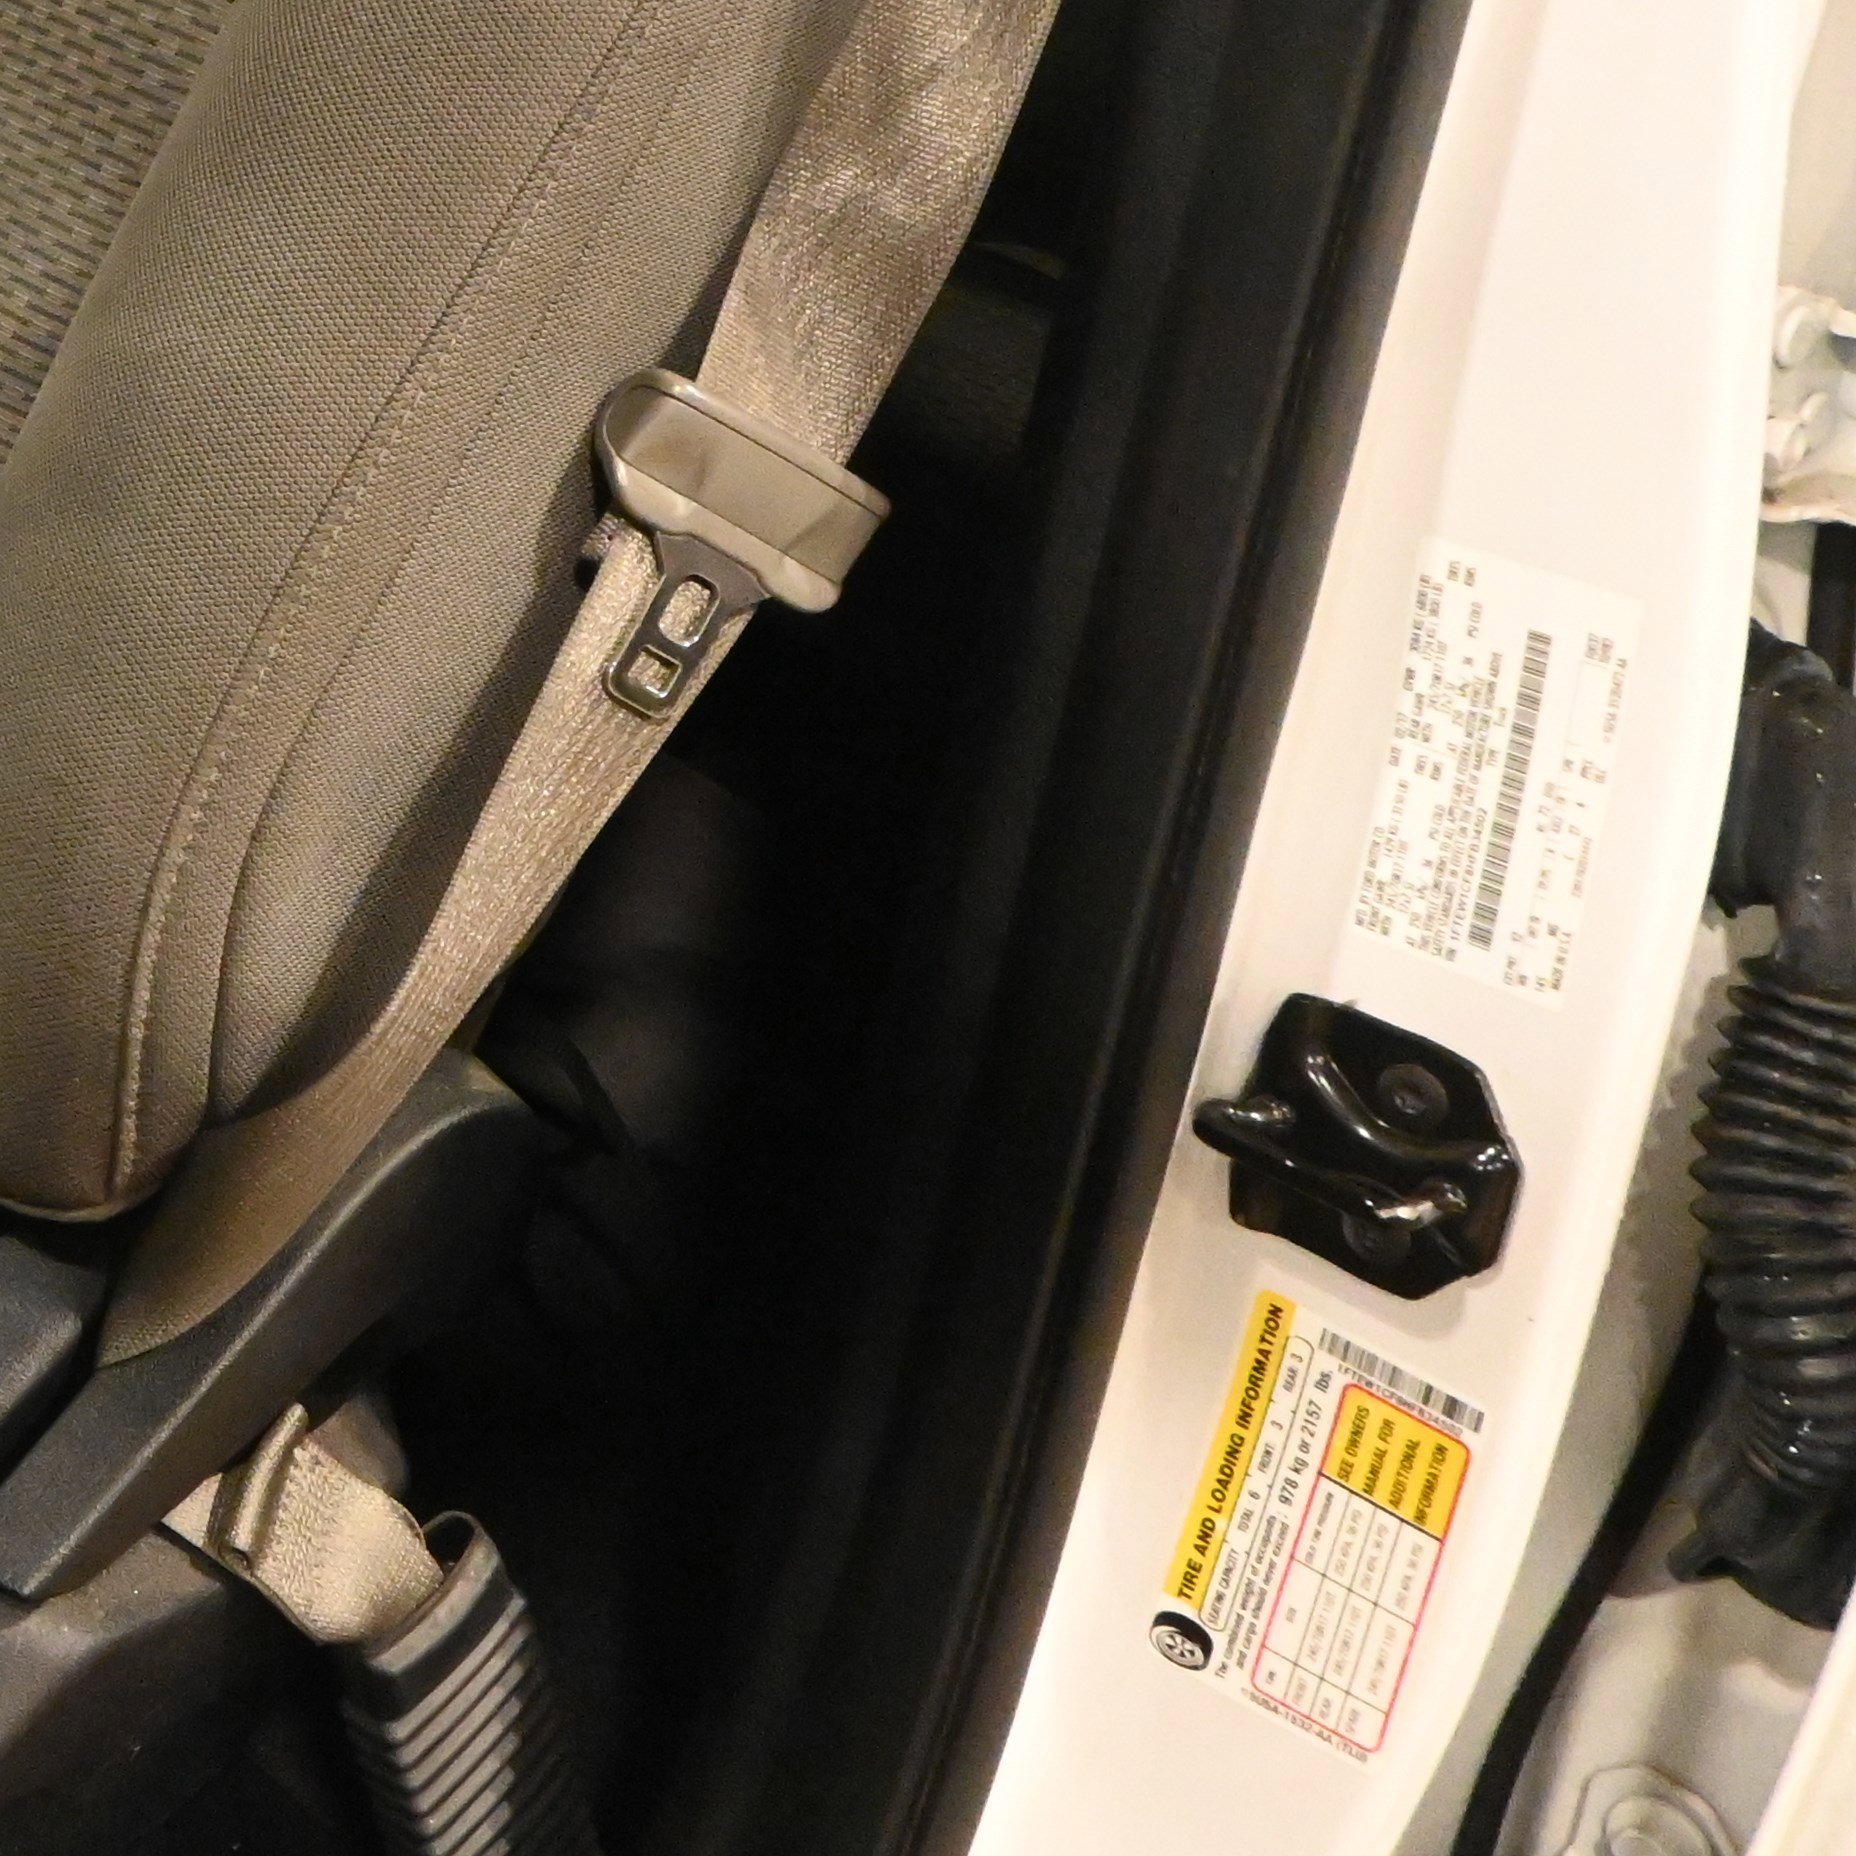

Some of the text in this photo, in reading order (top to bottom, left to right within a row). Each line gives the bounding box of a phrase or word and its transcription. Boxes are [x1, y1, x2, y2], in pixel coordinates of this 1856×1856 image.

[1482, 679, 1497, 710] SHOWN
[1487, 651, 1502, 678] ABOVE
[1462, 709, 1477, 739] MOTOR
[1442, 825, 1454, 840] ALL
[1460, 809, 1471, 823] THE
[1464, 786, 1476, 807] DATE
[1440, 841, 1450, 852] TO
[1431, 928, 1445, 957] SAFETY
[1177, 1301, 1286, 1605] TIRE AND LOADING INFORMATION
[1277, 1364, 1334, 1509] 978 kg or 2157 lbs.
[1336, 1404, 1370, 1483] SEE OWNERS
[1361, 1417, 1396, 1497] MANUAL FOR
[1386, 1435, 1421, 1510] ADDITIONAL
[1411, 1442, 1450, 1528] INFORMATION
[1206, 1546, 1239, 1627] SEATING CAPACITY
[1214, 1512, 1278, 1681] The combined weight of occupants
[1234, 1649, 1247, 1670] and
[1241, 1620, 1259, 1652] cargo
[1250, 1585, 1268, 1621] should
[1262, 1558, 1277, 1587] never
